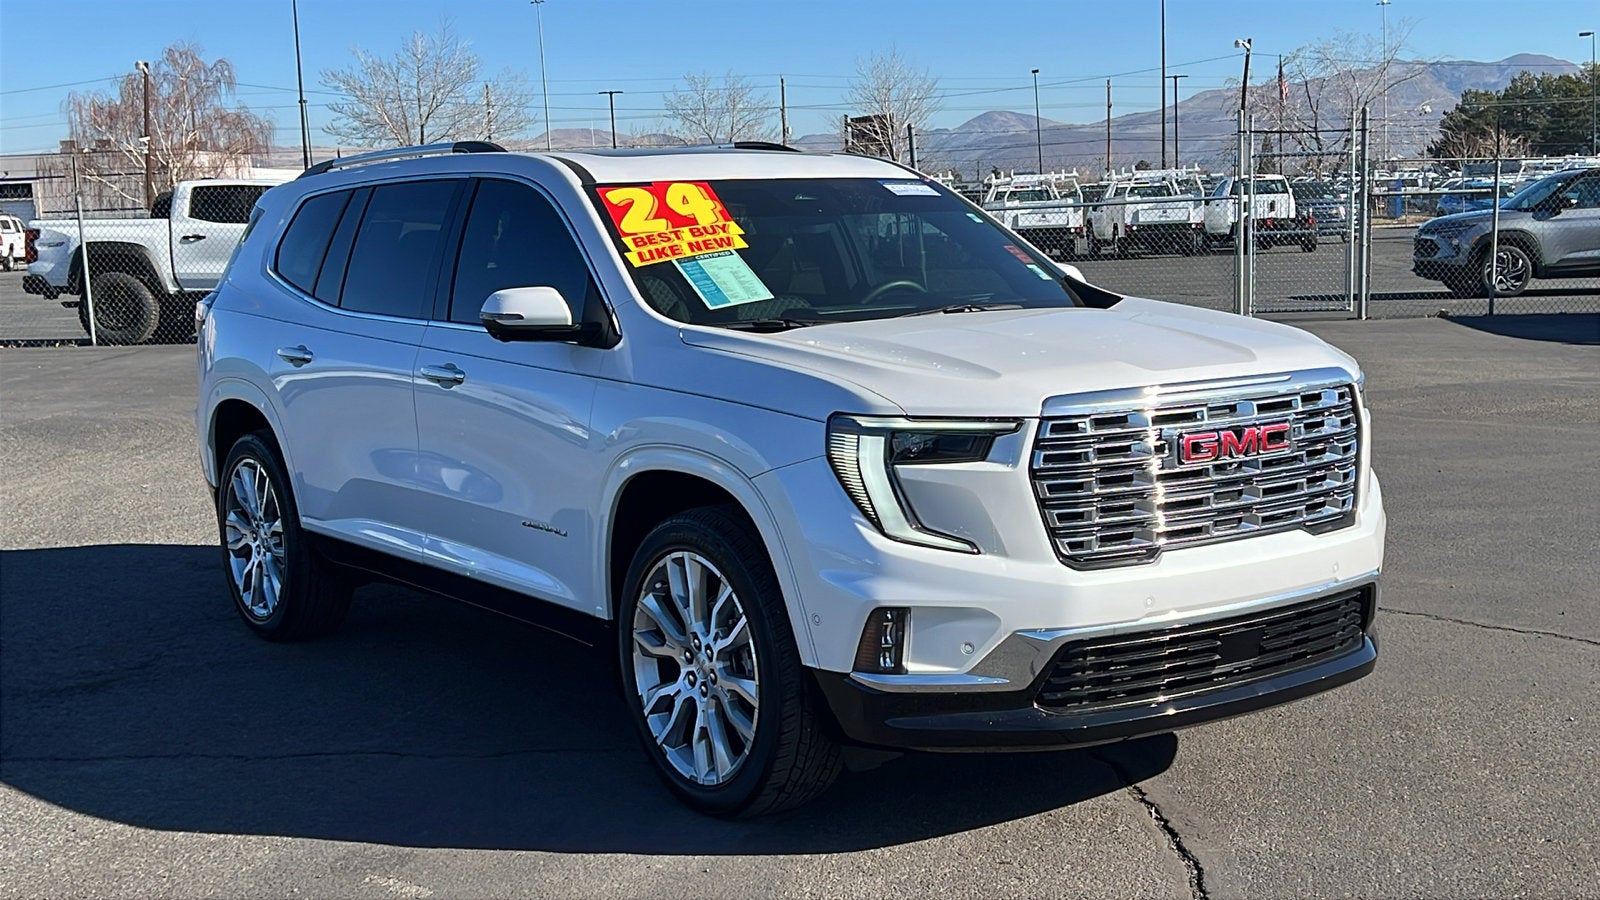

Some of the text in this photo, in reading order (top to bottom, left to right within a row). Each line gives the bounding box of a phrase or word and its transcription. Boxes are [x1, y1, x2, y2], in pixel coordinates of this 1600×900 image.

[605, 182, 721, 234] 24
[632, 223, 729, 248] BEST BUY
[636, 245, 685, 263] LIKE
[687, 237, 734, 253] NEW
[695, 250, 731, 260] CERTIFIED
[1182, 422, 1291, 463] GMC
